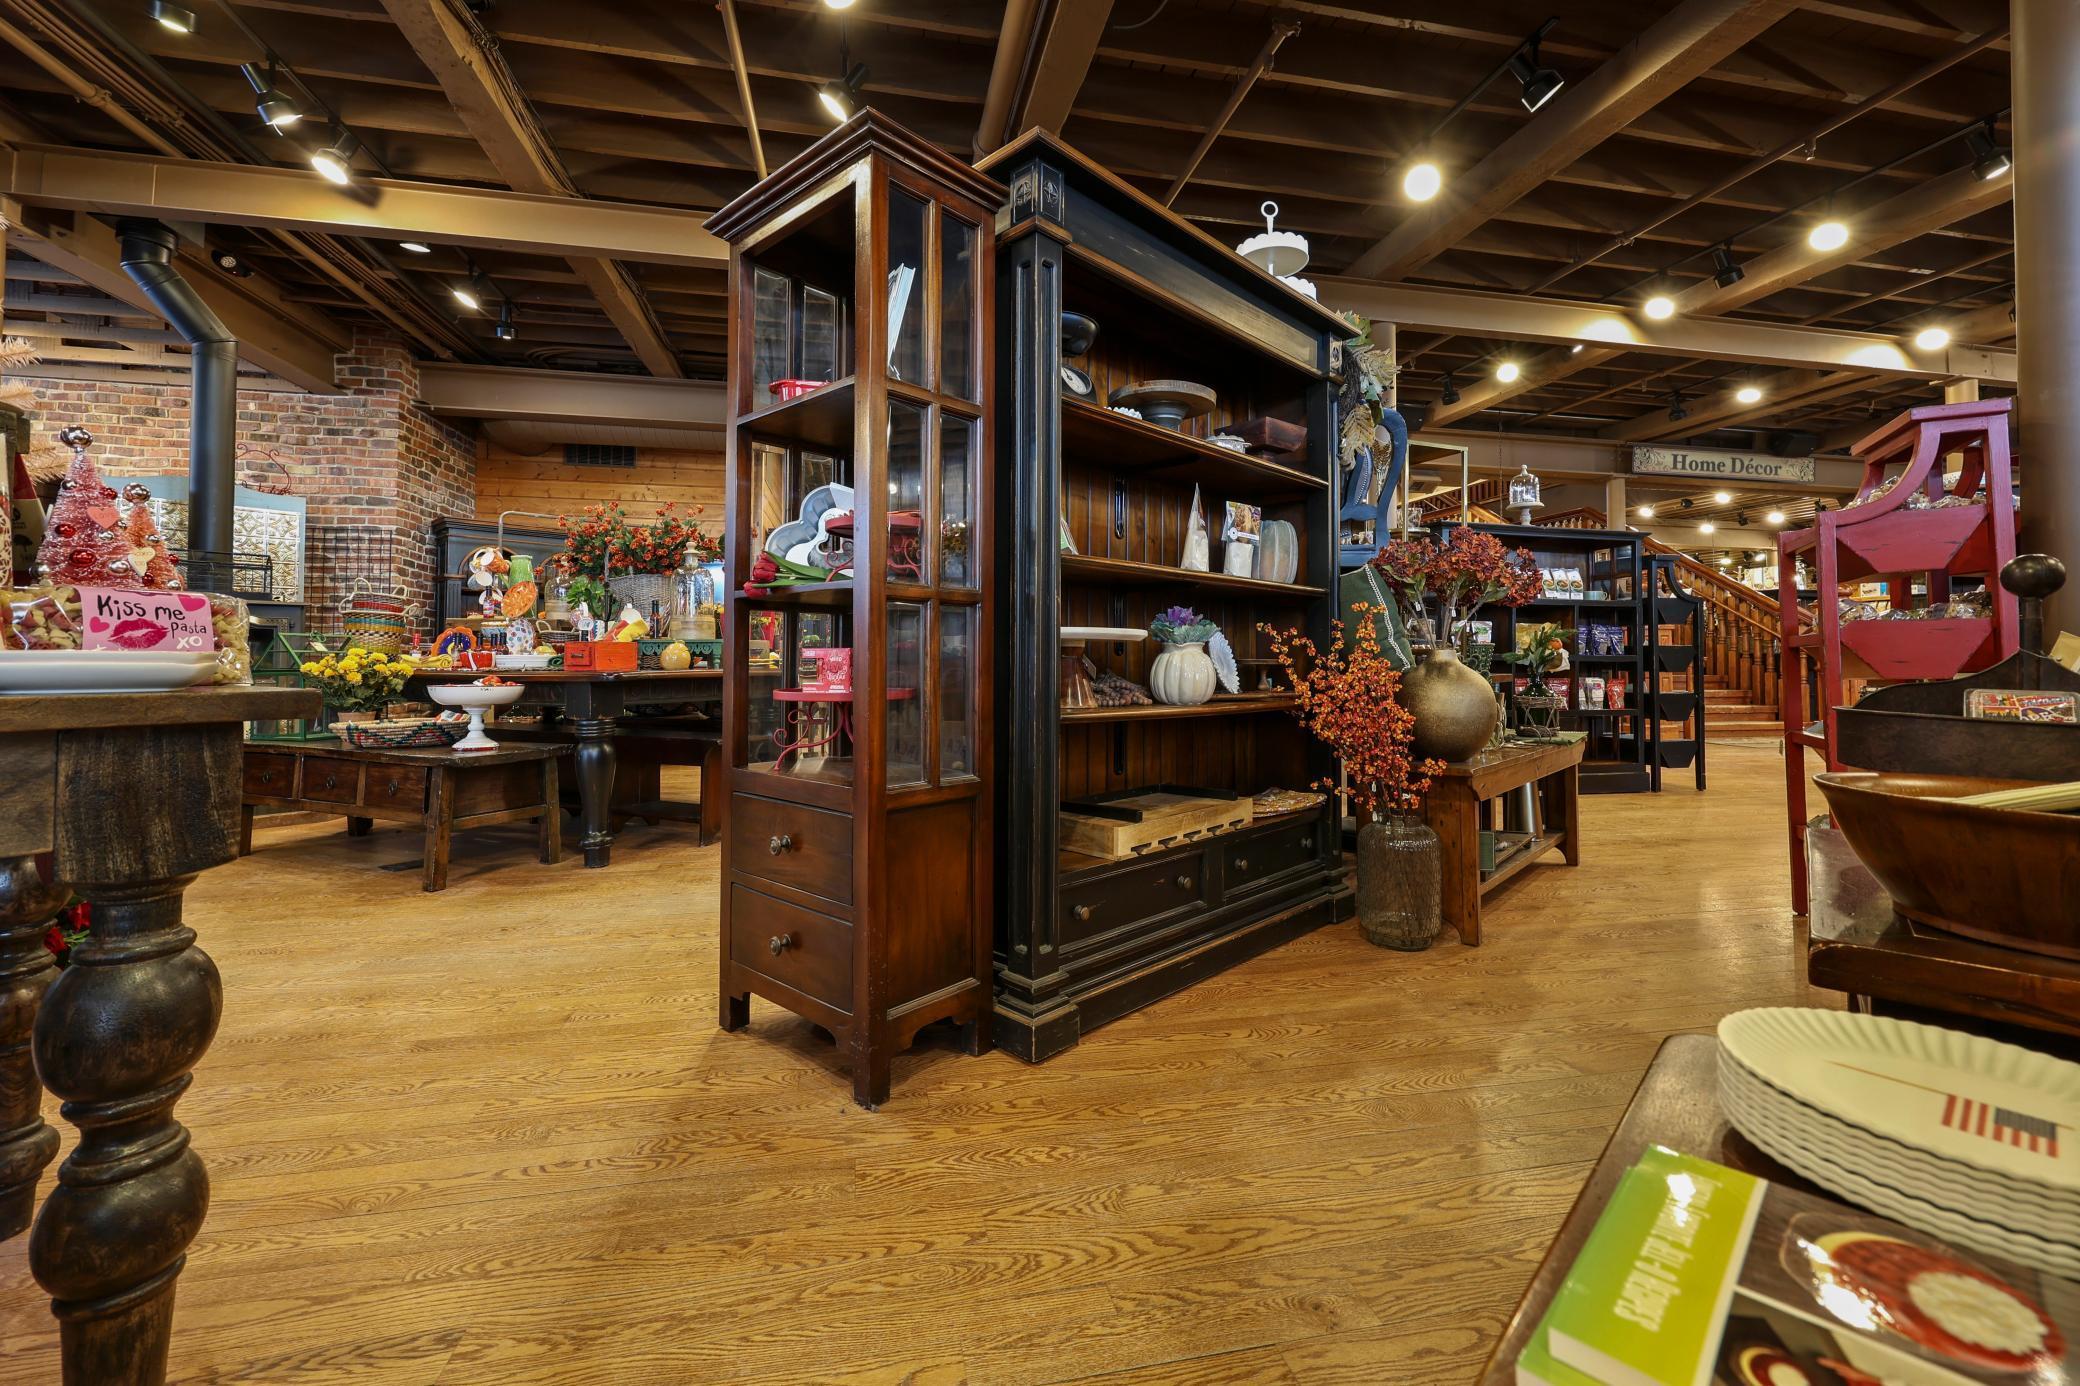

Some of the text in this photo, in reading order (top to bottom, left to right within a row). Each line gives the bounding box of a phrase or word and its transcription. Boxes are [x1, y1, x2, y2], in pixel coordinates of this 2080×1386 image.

[1671, 453, 1782, 476] Home Décor
[97, 595, 185, 621] Kiss me
[171, 621, 207, 639] pasta
